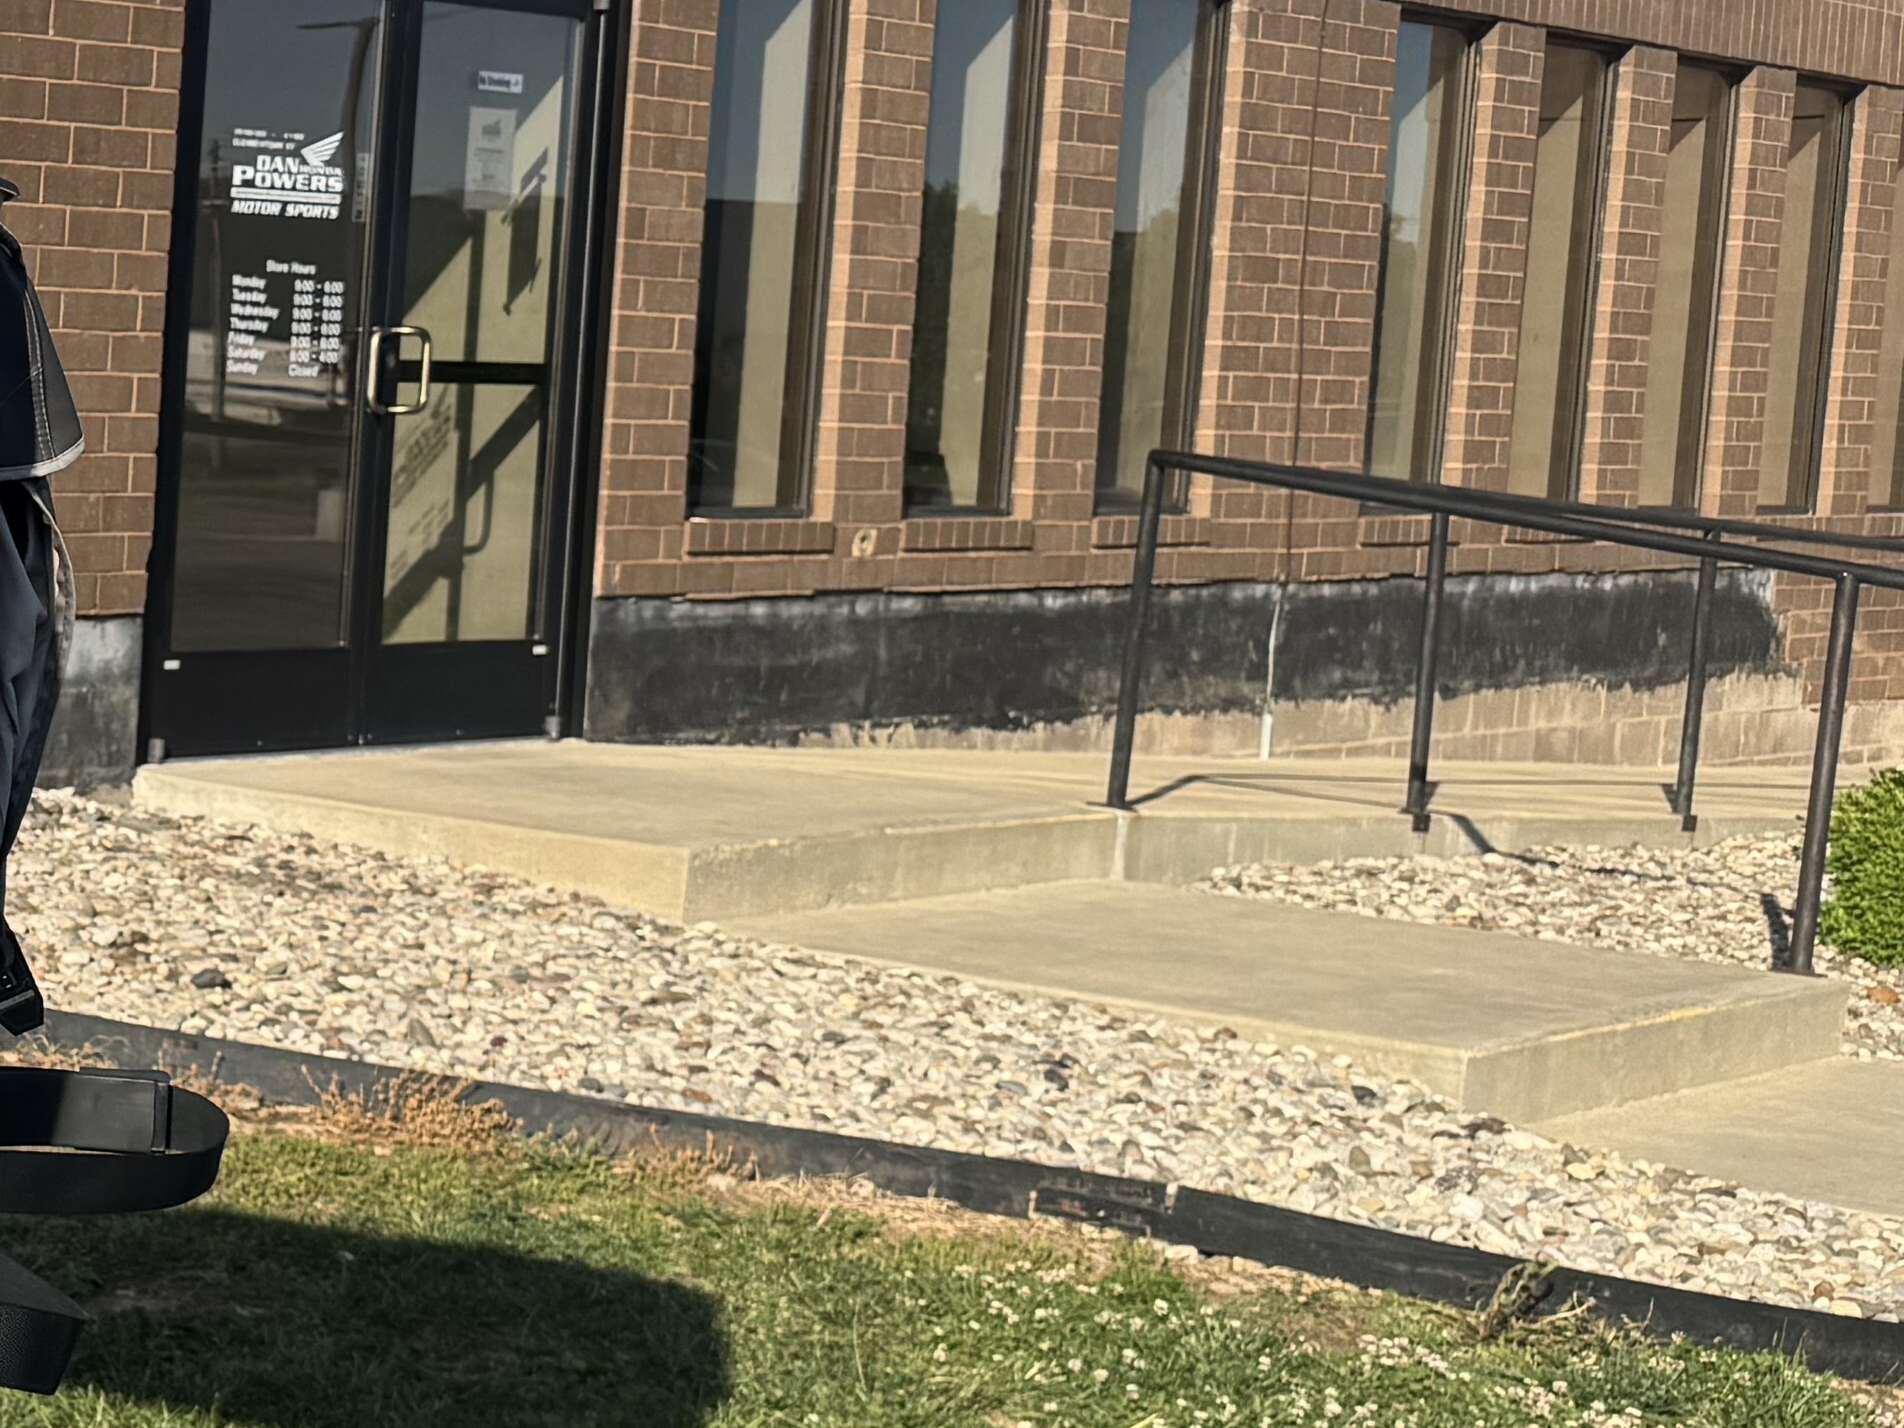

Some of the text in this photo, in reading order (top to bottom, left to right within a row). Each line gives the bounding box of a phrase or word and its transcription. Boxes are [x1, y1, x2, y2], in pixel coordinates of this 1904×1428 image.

[256, 155, 299, 173] DAN
[232, 164, 344, 192] POWERS
[231, 200, 340, 220] MOTOR SPORTS
